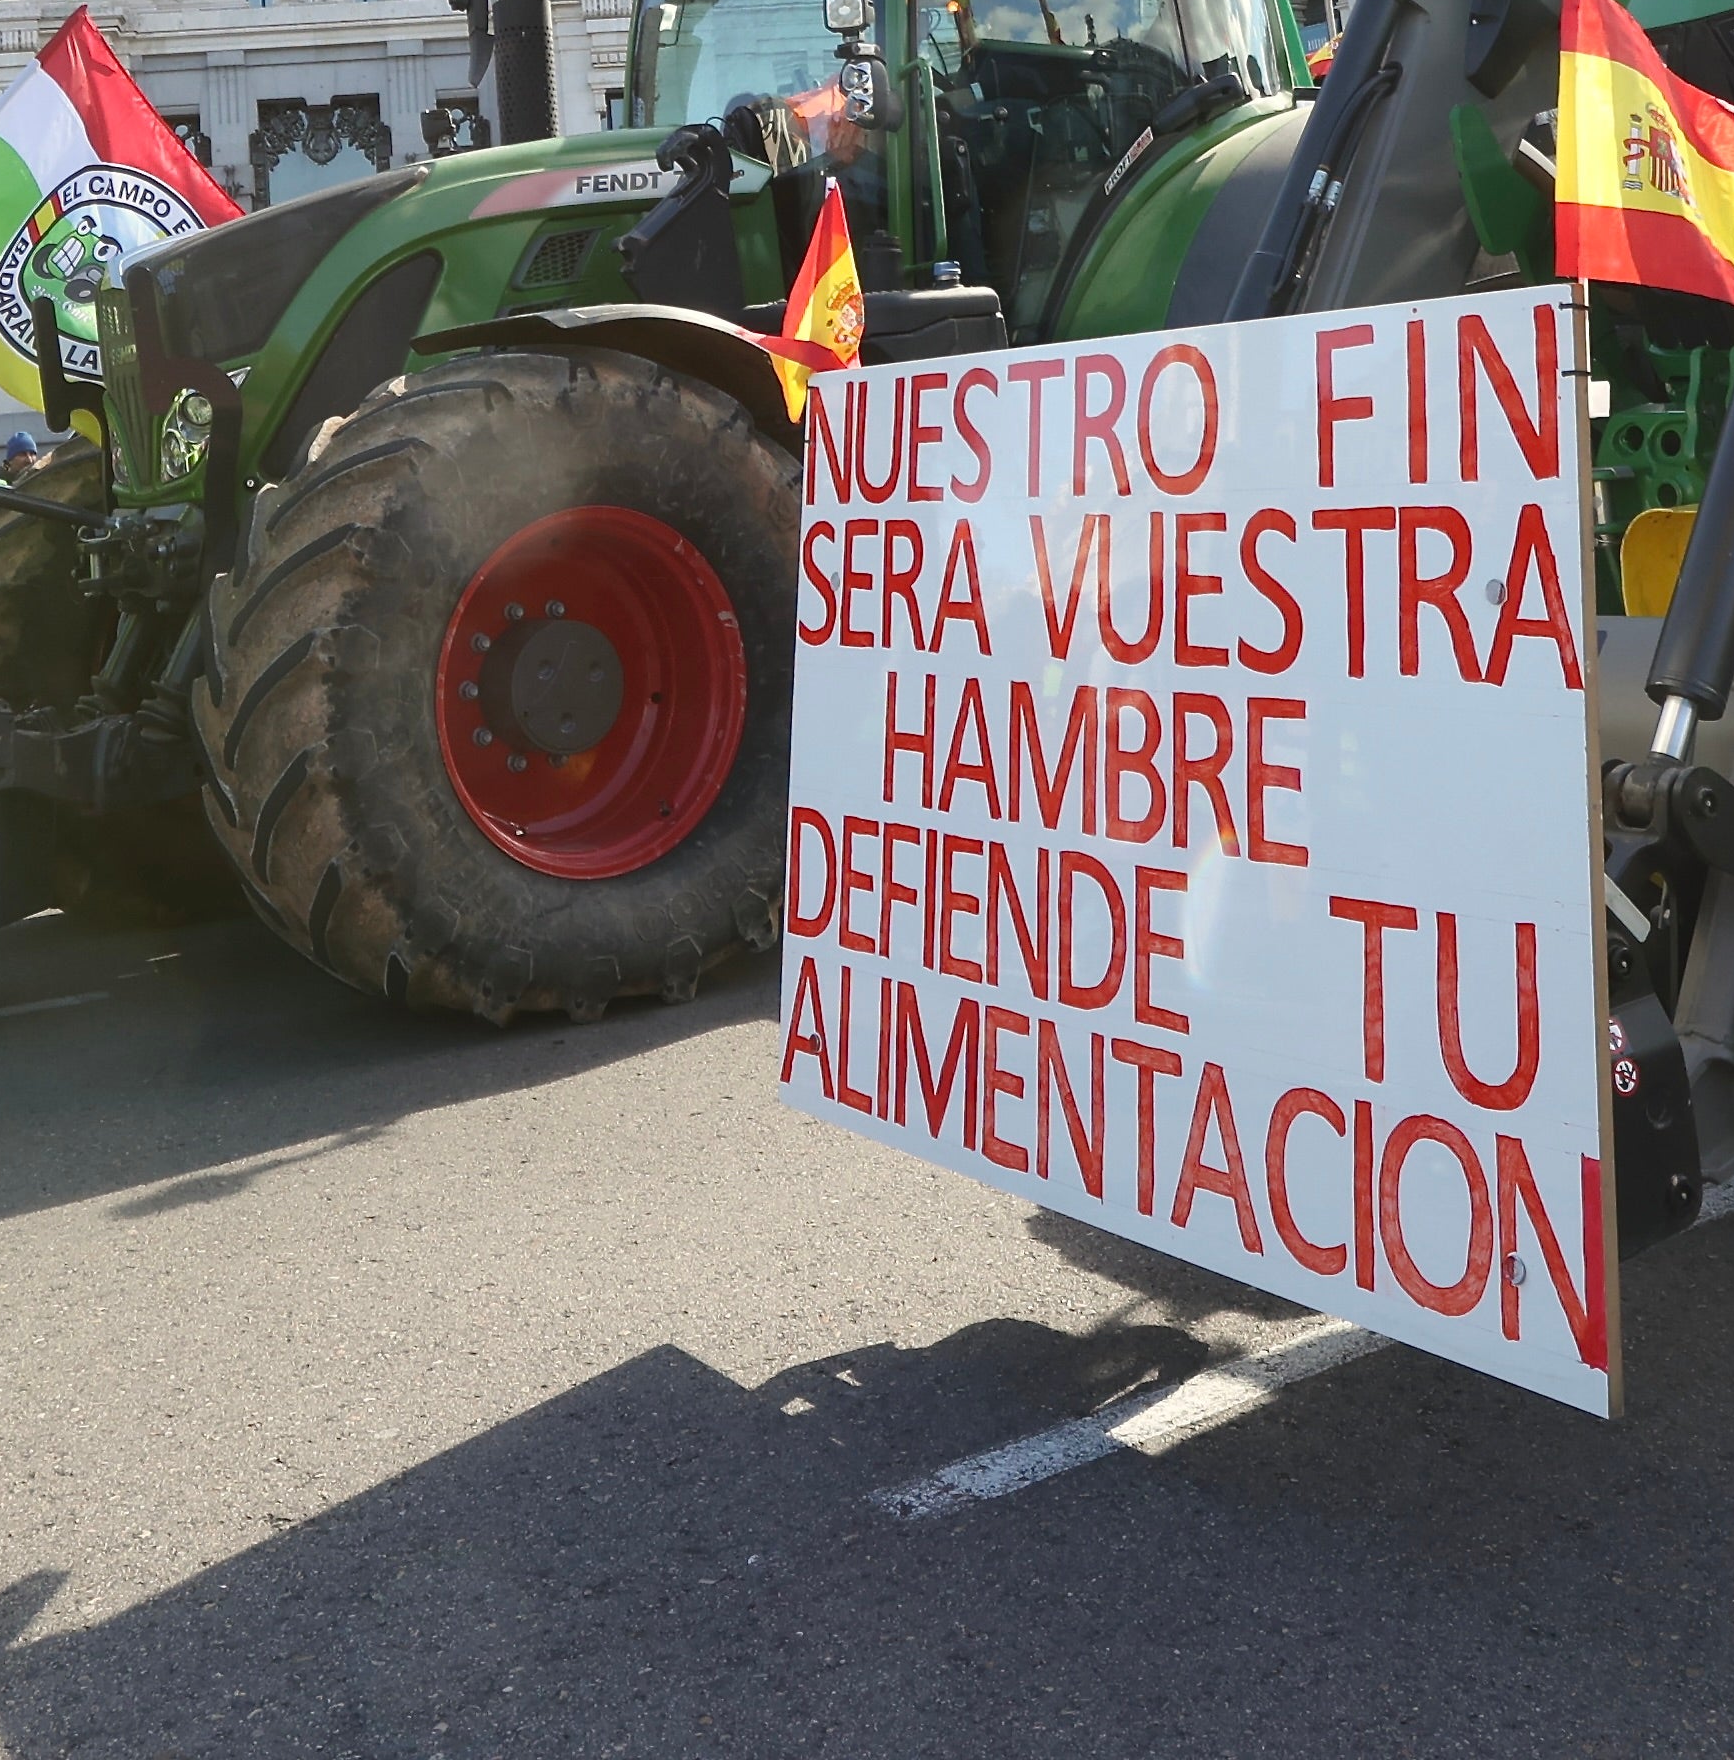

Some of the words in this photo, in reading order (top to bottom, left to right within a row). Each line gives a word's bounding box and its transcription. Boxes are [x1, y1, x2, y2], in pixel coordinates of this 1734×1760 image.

[62, 181, 82, 207] EL
[88, 176, 172, 218] CAMPO
[172, 218, 192, 235] E
[575, 172, 662, 195] FENDT
[64, 345, 99, 371] LA
[806, 342, 1220, 506] NUESTRO
[1315, 302, 1560, 488] FIN
[796, 516, 993, 657] SERA
[1029, 503, 1584, 690] VUESTRA
[882, 671, 1309, 867] HAMBRE
[786, 805, 1191, 1034] DEFIENDE
[1328, 895, 1540, 1112] TU
[779, 956, 1608, 1373] ALIMENTACION
